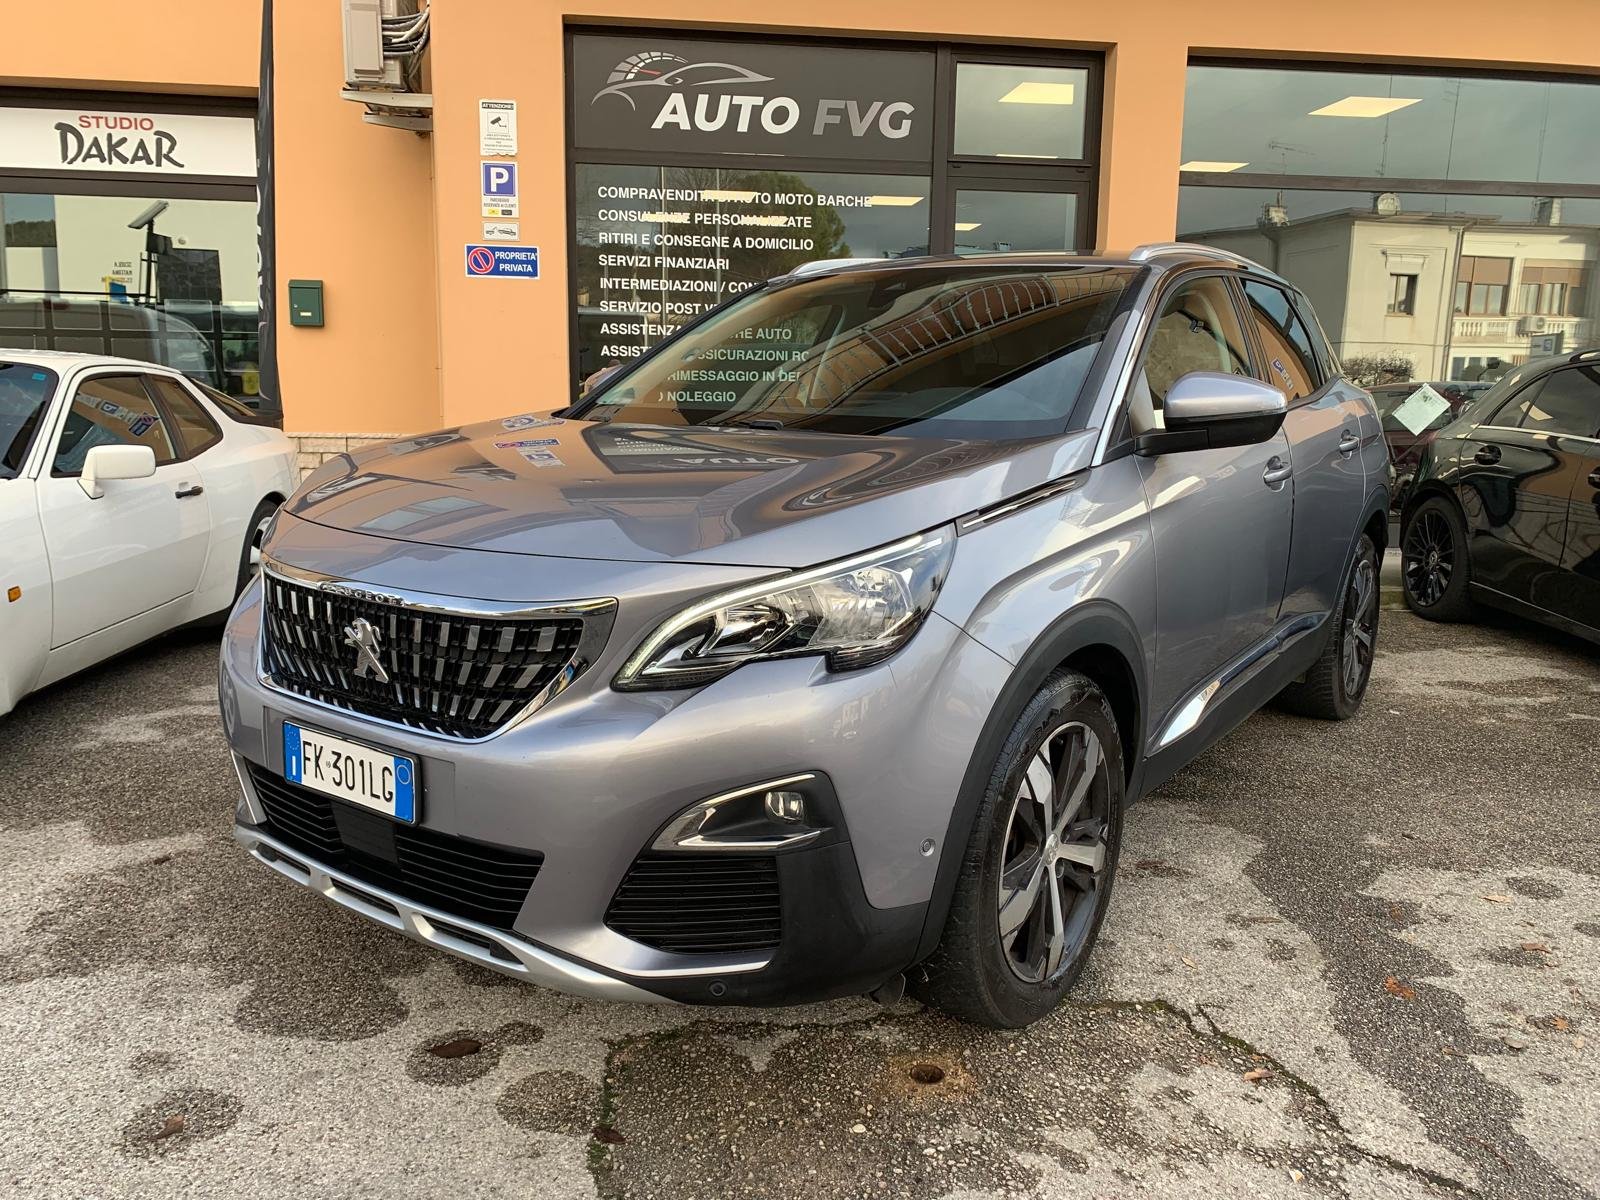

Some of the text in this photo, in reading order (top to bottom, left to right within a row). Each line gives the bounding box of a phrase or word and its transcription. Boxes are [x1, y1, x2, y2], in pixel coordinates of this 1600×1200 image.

[78, 115, 154, 131] STUDIO
[651, 92, 915, 139] AUTO FVG
[54, 121, 185, 168] DAKAR
[490, 166, 509, 192] P
[775, 193, 813, 206] MOTO
[817, 195, 873, 208] BARCHE
[598, 209, 812, 229] CONSUE PERSOZATE
[598, 232, 814, 251] RITIRI E CONSEGNE A DOMICILIO
[499, 263, 533, 272] PRIVATA
[598, 254, 730, 270] SERVIZI FINANZIARI
[600, 278, 718, 293] INTERMEDIAZIONI
[720, 281, 726, 293] /
[600, 300, 662, 314] SERVIZIO
[665, 302, 702, 315] POST
[730, 328, 752, 339] HE
[755, 328, 792, 340] AUTO
[600, 345, 652, 358] ASSIST
[762, 371, 775, 382] IN
[667, 391, 736, 402] NOLEGGIO
